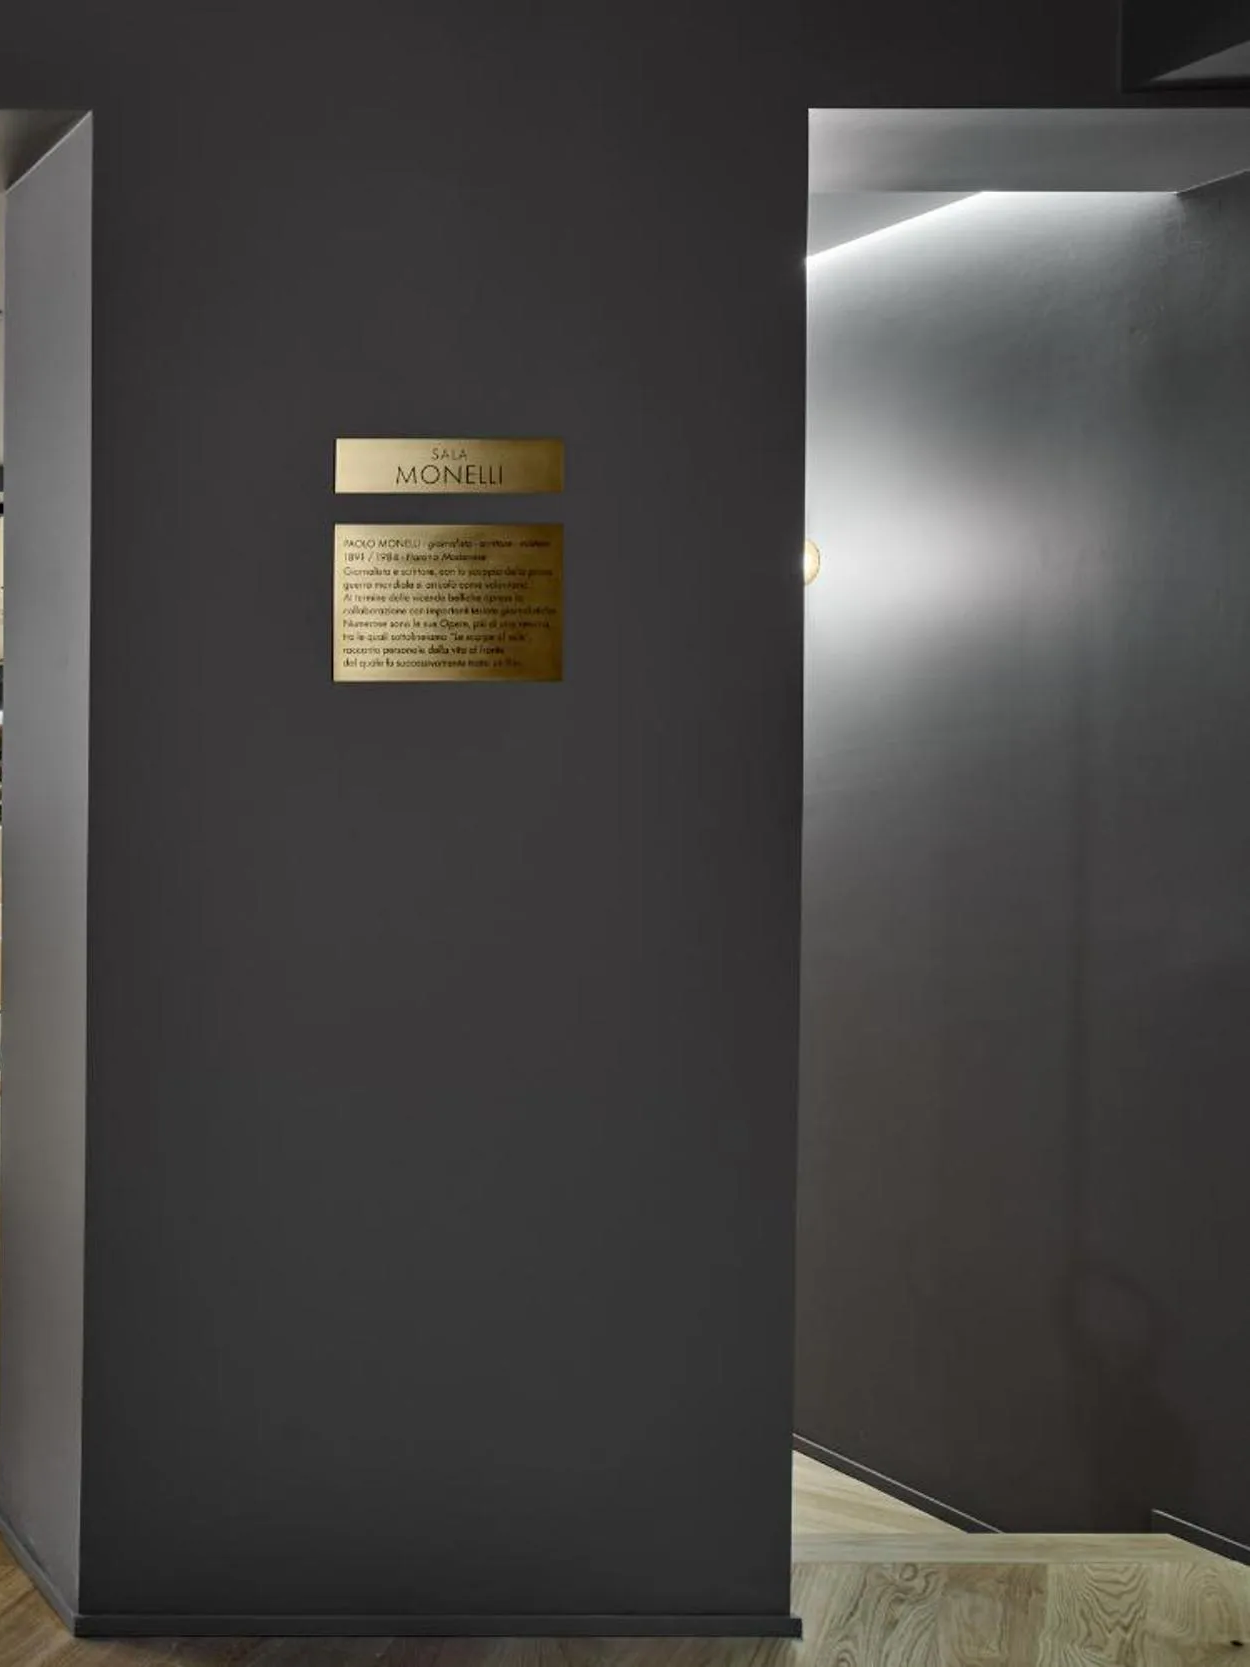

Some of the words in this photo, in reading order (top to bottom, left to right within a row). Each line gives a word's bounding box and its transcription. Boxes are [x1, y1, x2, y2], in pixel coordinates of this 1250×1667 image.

[432, 448, 467, 461] SALA
[396, 465, 503, 485] MONELLI
[344, 539, 375, 548] PAOLO
[378, 539, 421, 548] MONELLI
[342, 658, 357, 667] del
